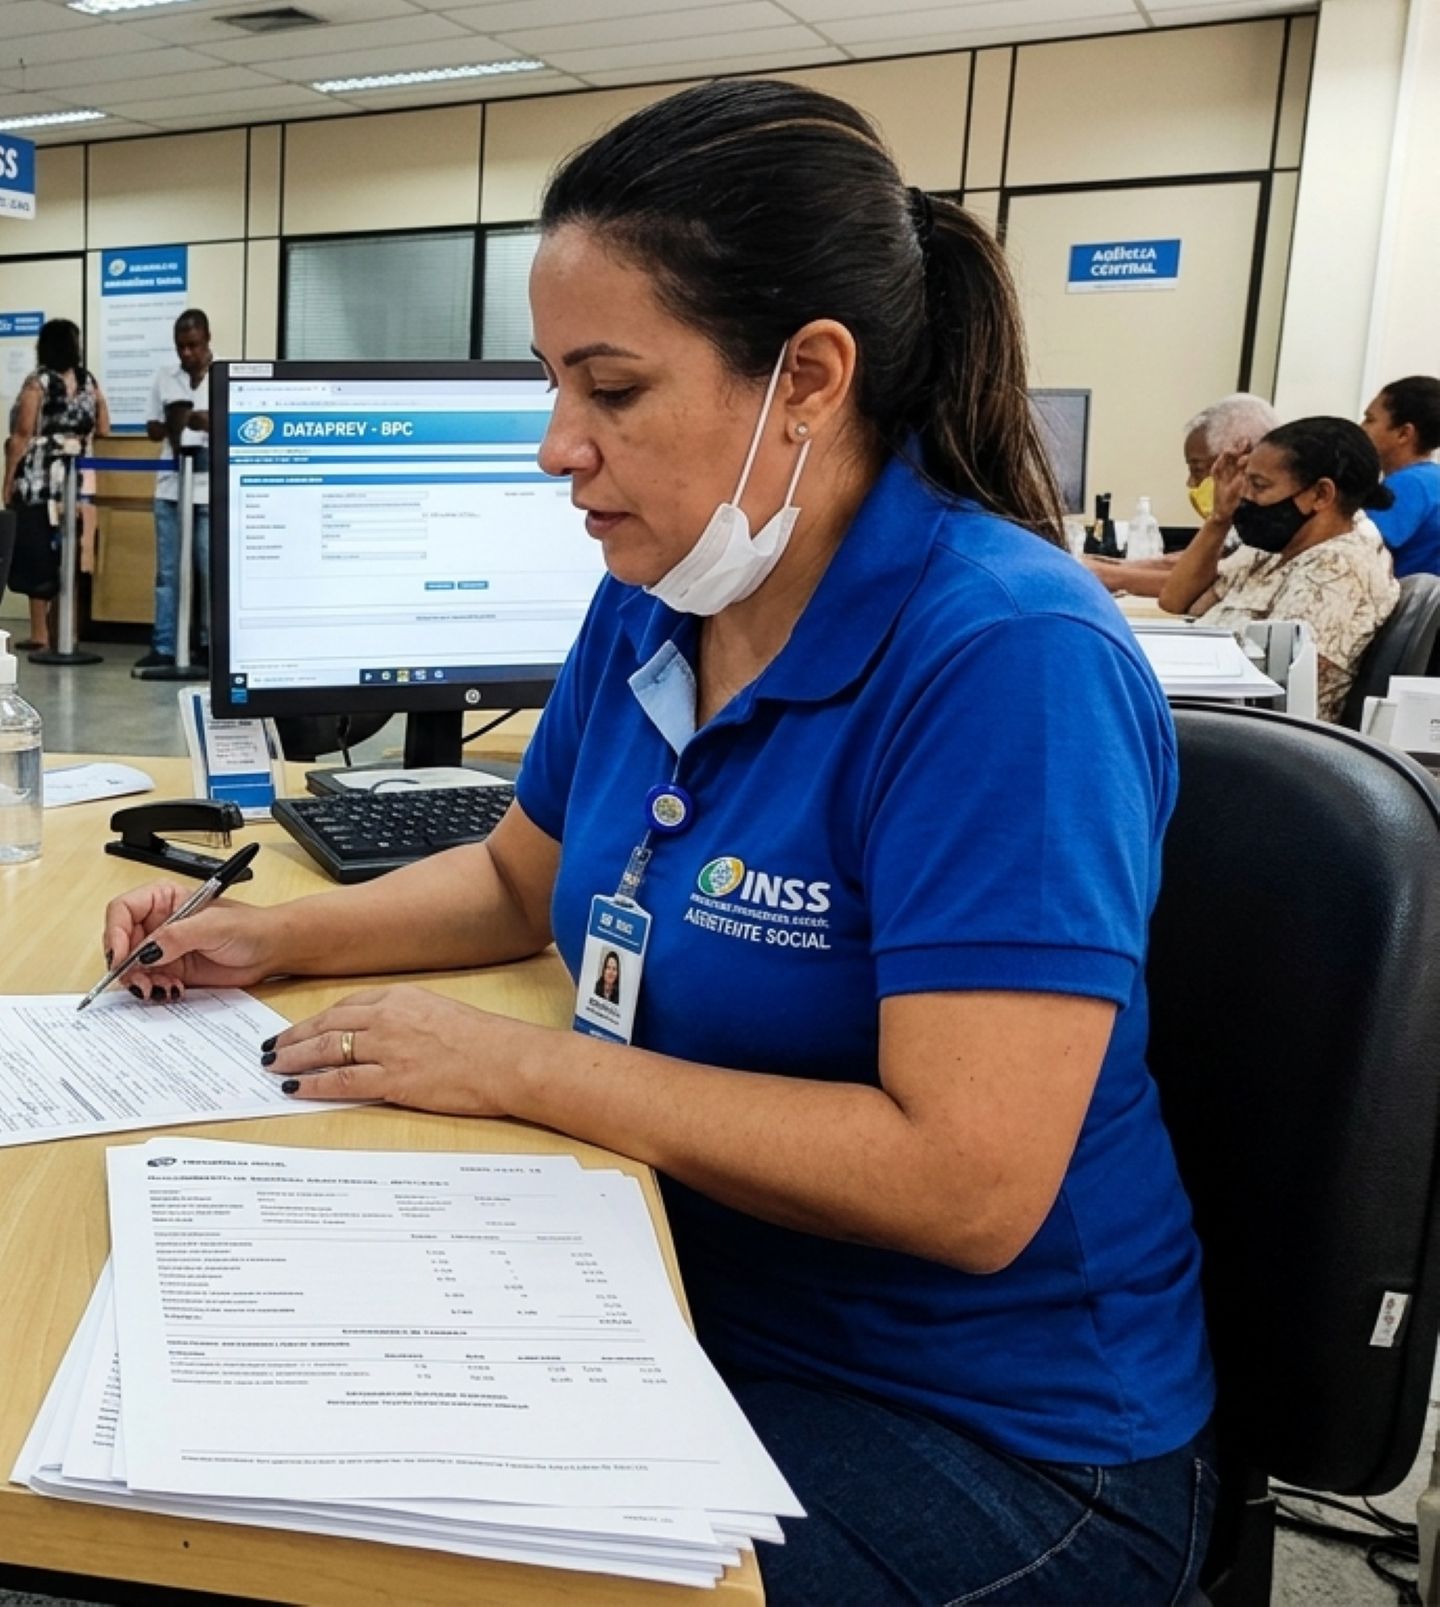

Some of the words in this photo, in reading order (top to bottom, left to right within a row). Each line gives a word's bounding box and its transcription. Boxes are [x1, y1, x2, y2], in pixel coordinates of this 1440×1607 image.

[381, 421, 413, 436] BPC
[740, 870, 831, 912] INSS
[765, 927, 831, 949] SOCIAL
